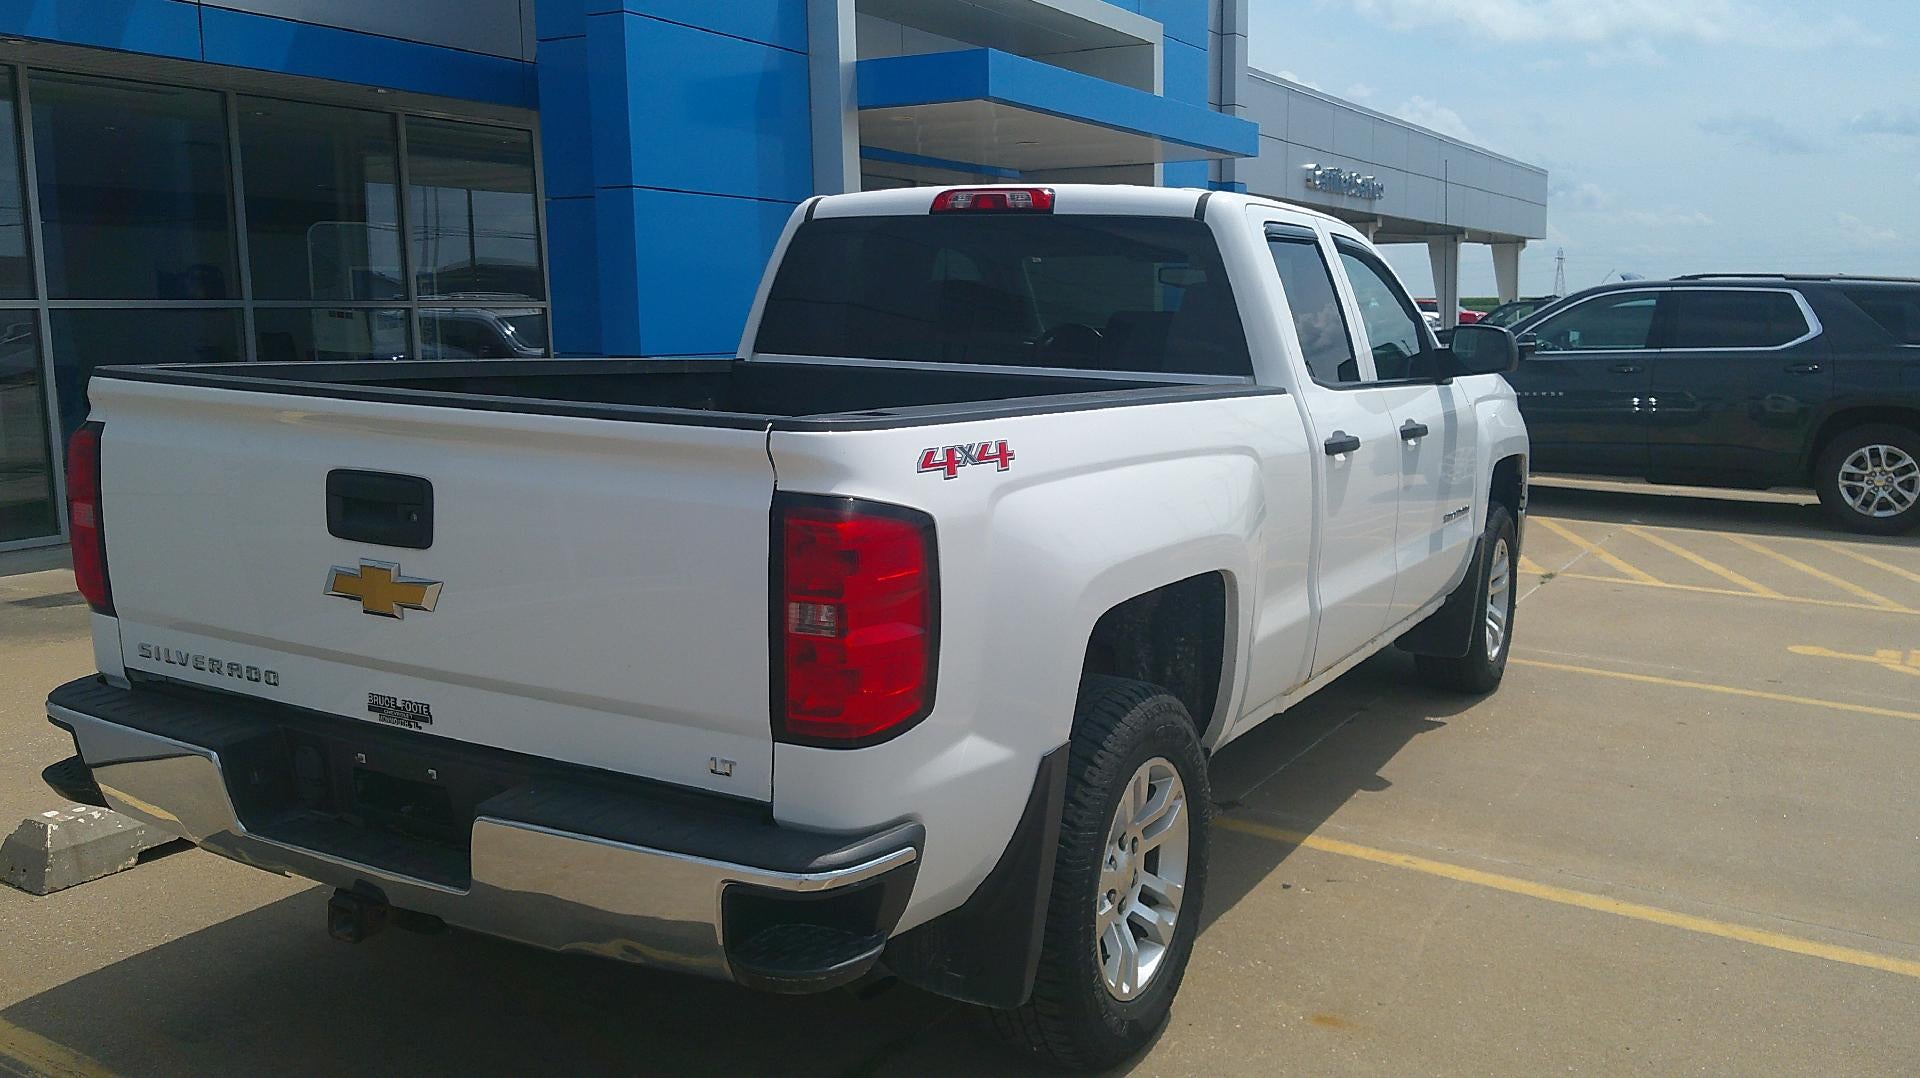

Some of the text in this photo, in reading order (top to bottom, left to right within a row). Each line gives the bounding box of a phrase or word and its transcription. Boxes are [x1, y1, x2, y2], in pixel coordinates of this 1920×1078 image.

[137, 642, 280, 687] SILVERADO
[368, 693, 429, 715] BRUCE FOOTE
[709, 756, 737, 777] LT
